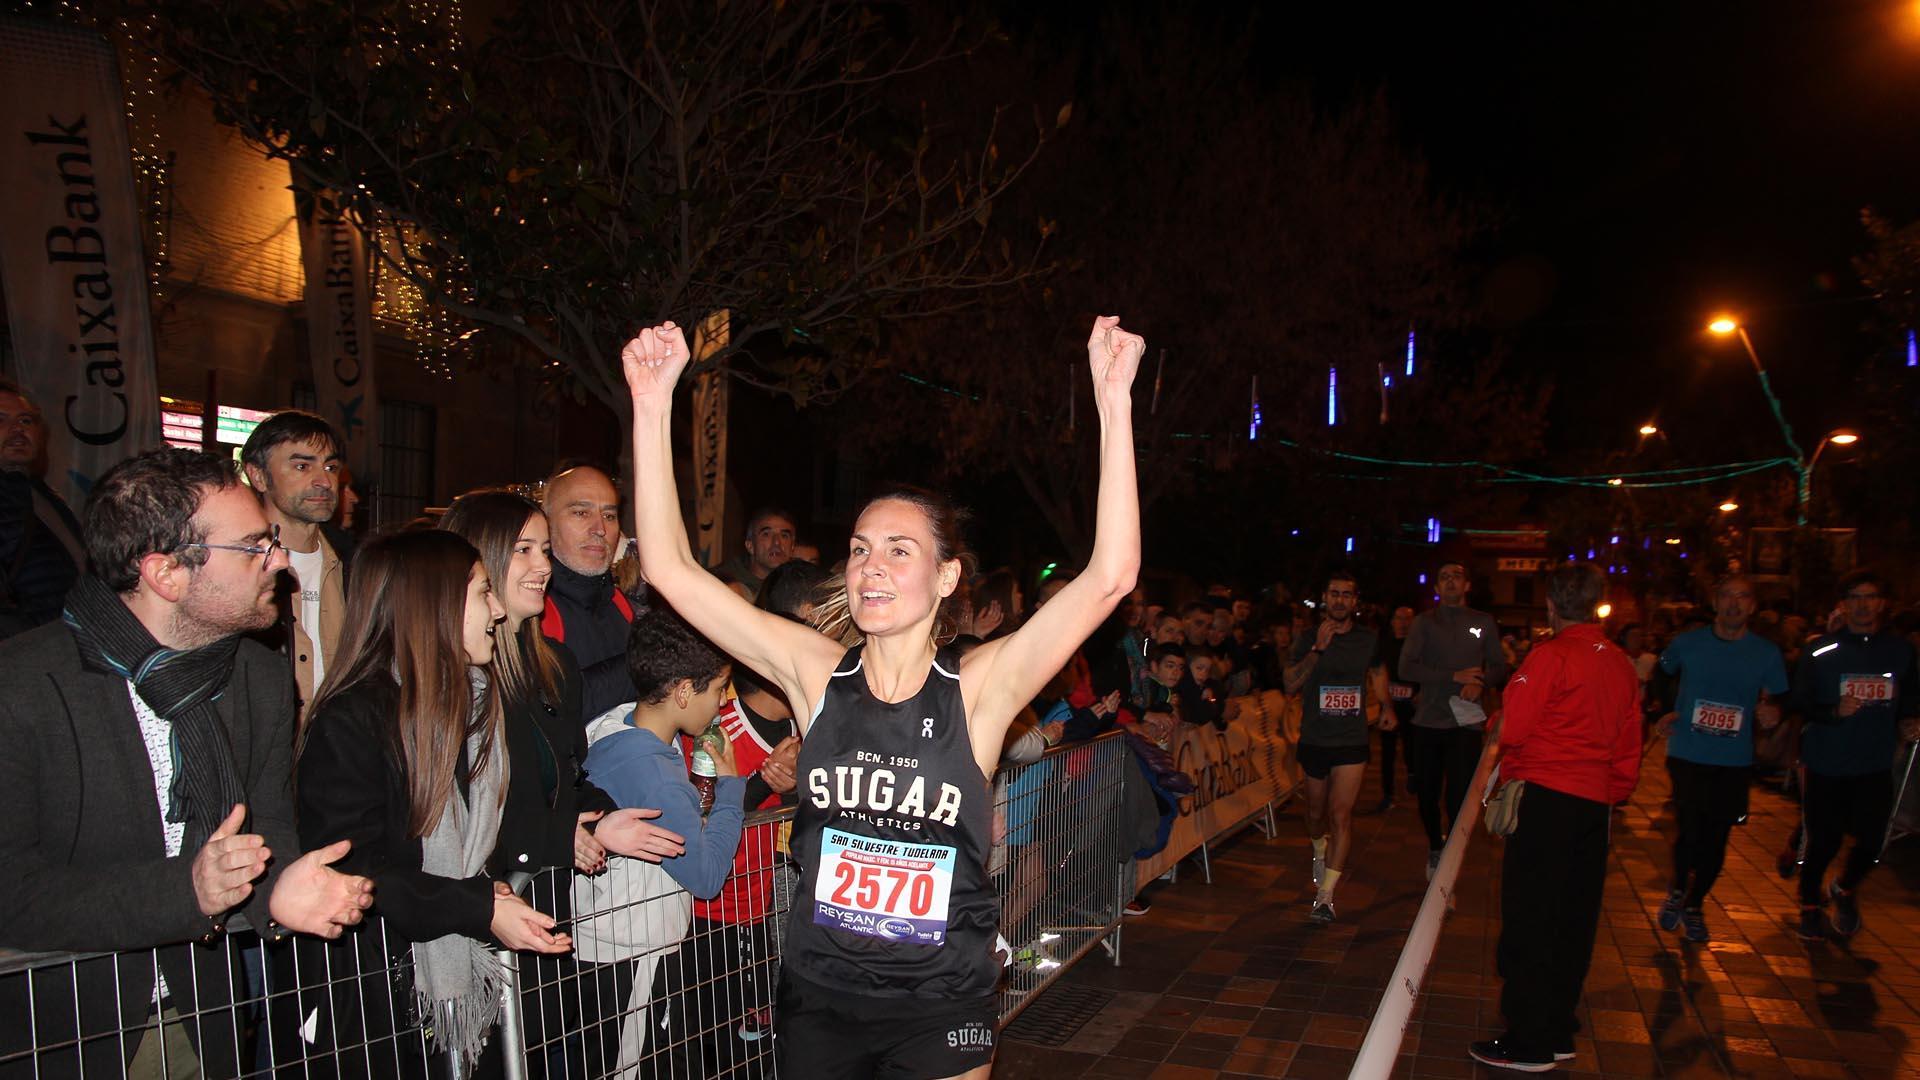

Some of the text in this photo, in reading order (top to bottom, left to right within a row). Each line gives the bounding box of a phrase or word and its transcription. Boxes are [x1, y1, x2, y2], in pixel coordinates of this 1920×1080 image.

[23, 112, 129, 446] CaixaBank
[1325, 695, 1357, 708] 2569
[1699, 710, 1736, 729] 2095
[856, 751, 919, 769] BCN. 1950
[808, 766, 962, 827] SUGAR
[840, 810, 921, 831] ATHLETICS
[830, 834, 949, 860] SAN SILVESTRE TUDELANA
[830, 861, 934, 917] 2570
[818, 904, 875, 926] REYSAN
[839, 922, 874, 935] ATLANTIC
[947, 1028, 993, 1048] SUGAR
